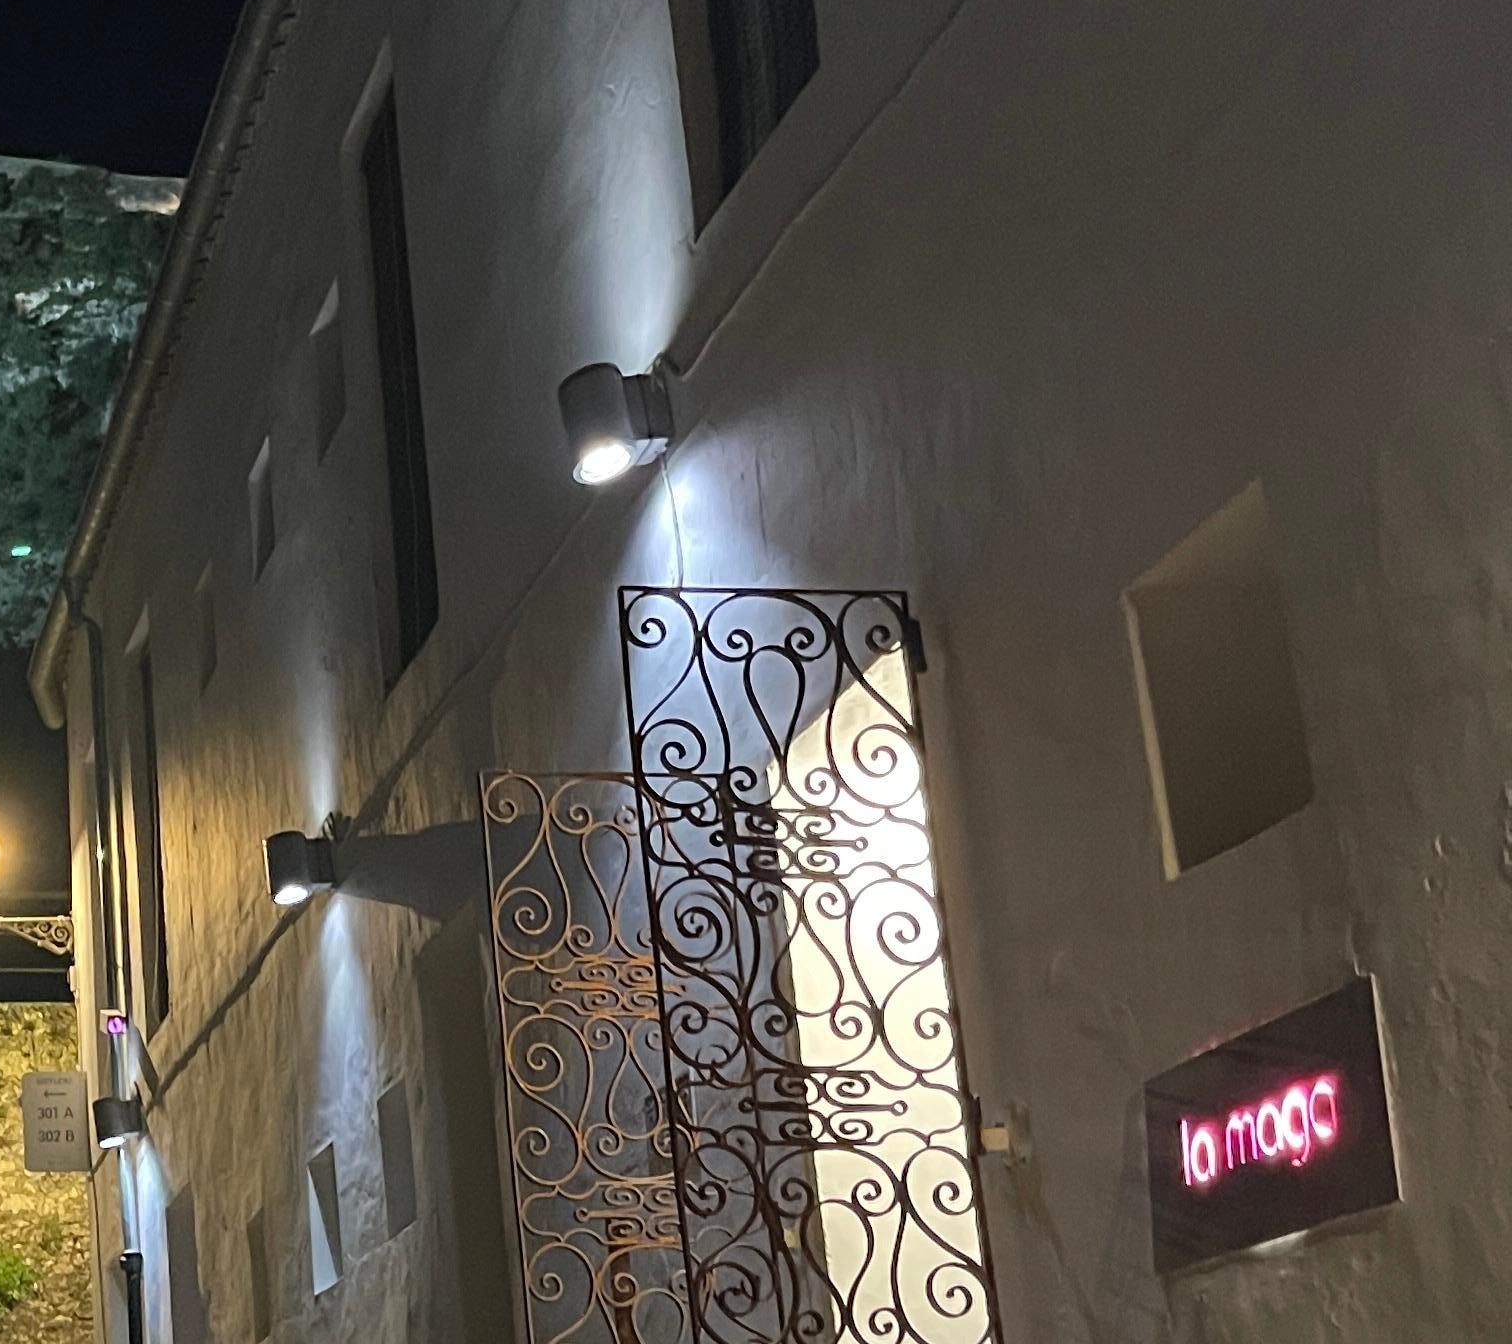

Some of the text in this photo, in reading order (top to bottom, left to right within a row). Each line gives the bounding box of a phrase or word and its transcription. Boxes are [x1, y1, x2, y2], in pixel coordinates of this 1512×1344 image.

[37, 1106, 74, 1120] 301 A
[38, 1129, 75, 1143] 302 B
[1180, 1079, 1338, 1187] la maga
